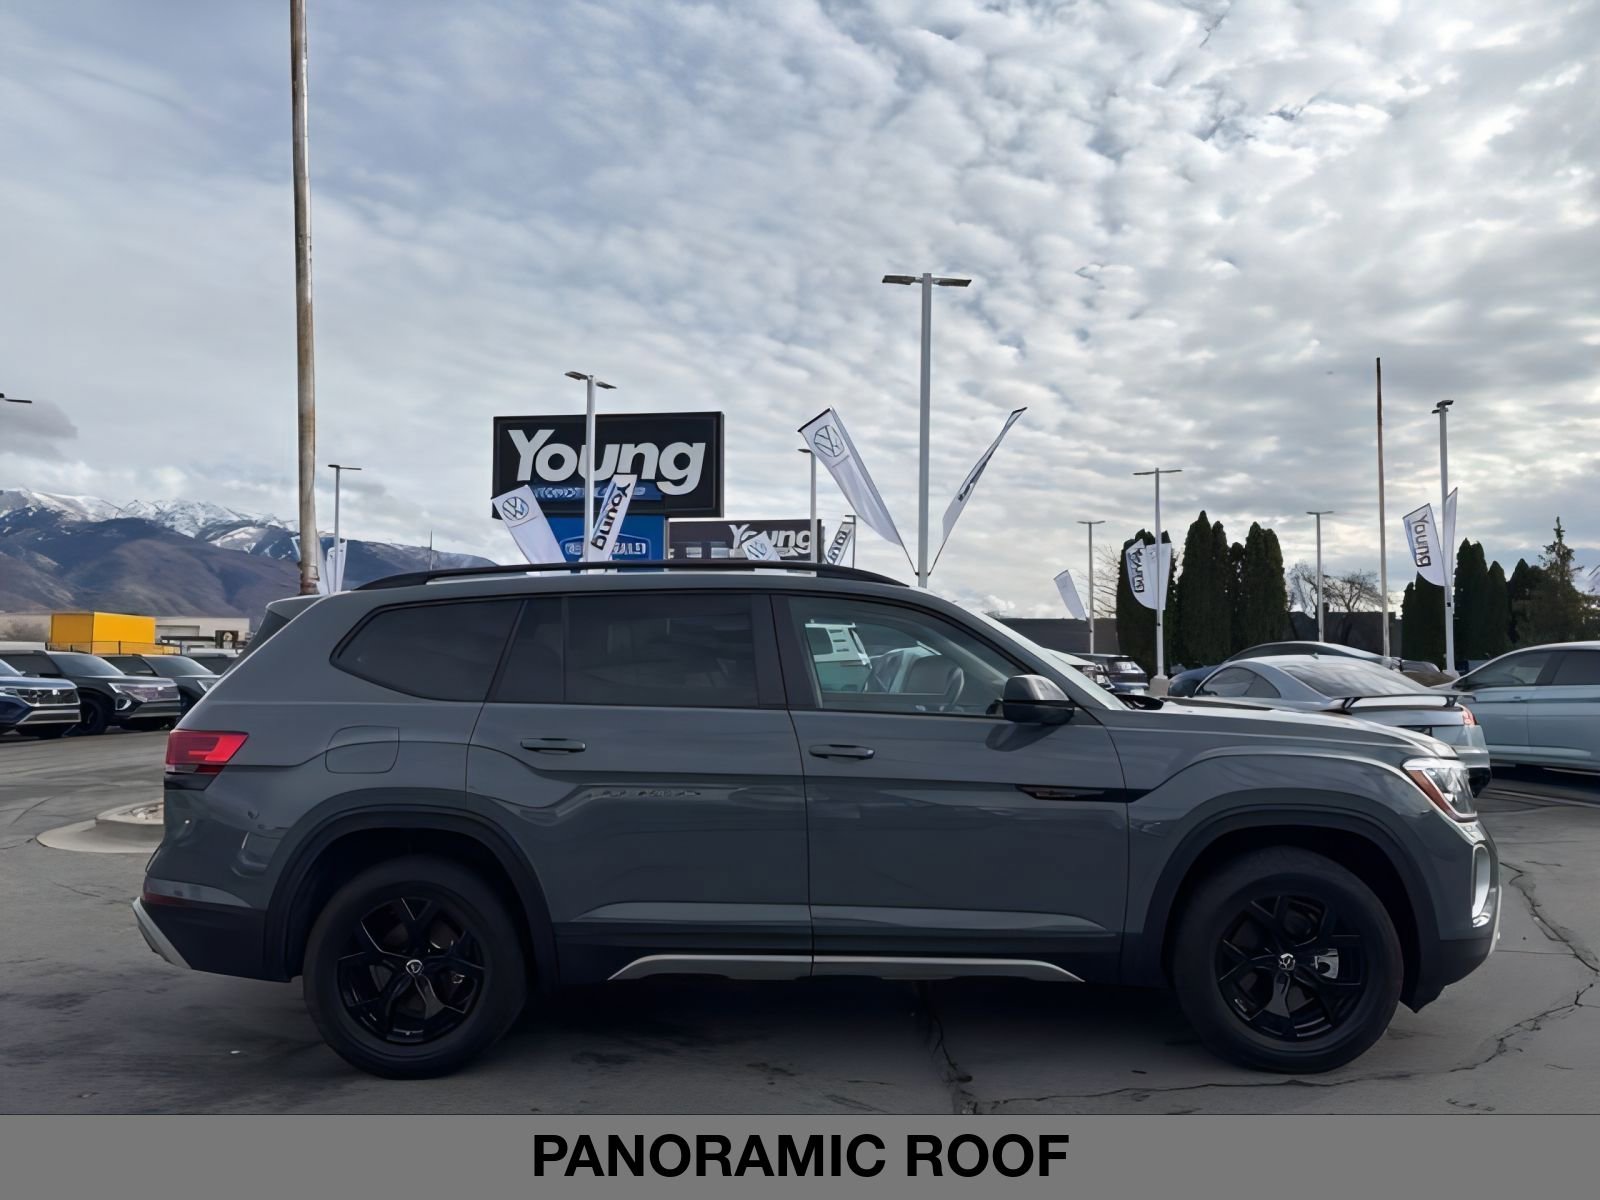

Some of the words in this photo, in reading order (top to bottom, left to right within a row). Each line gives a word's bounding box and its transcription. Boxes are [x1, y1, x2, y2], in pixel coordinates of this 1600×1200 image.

[508, 429, 706, 495] Young
[591, 483, 631, 550] Young
[1411, 514, 1431, 567] Young
